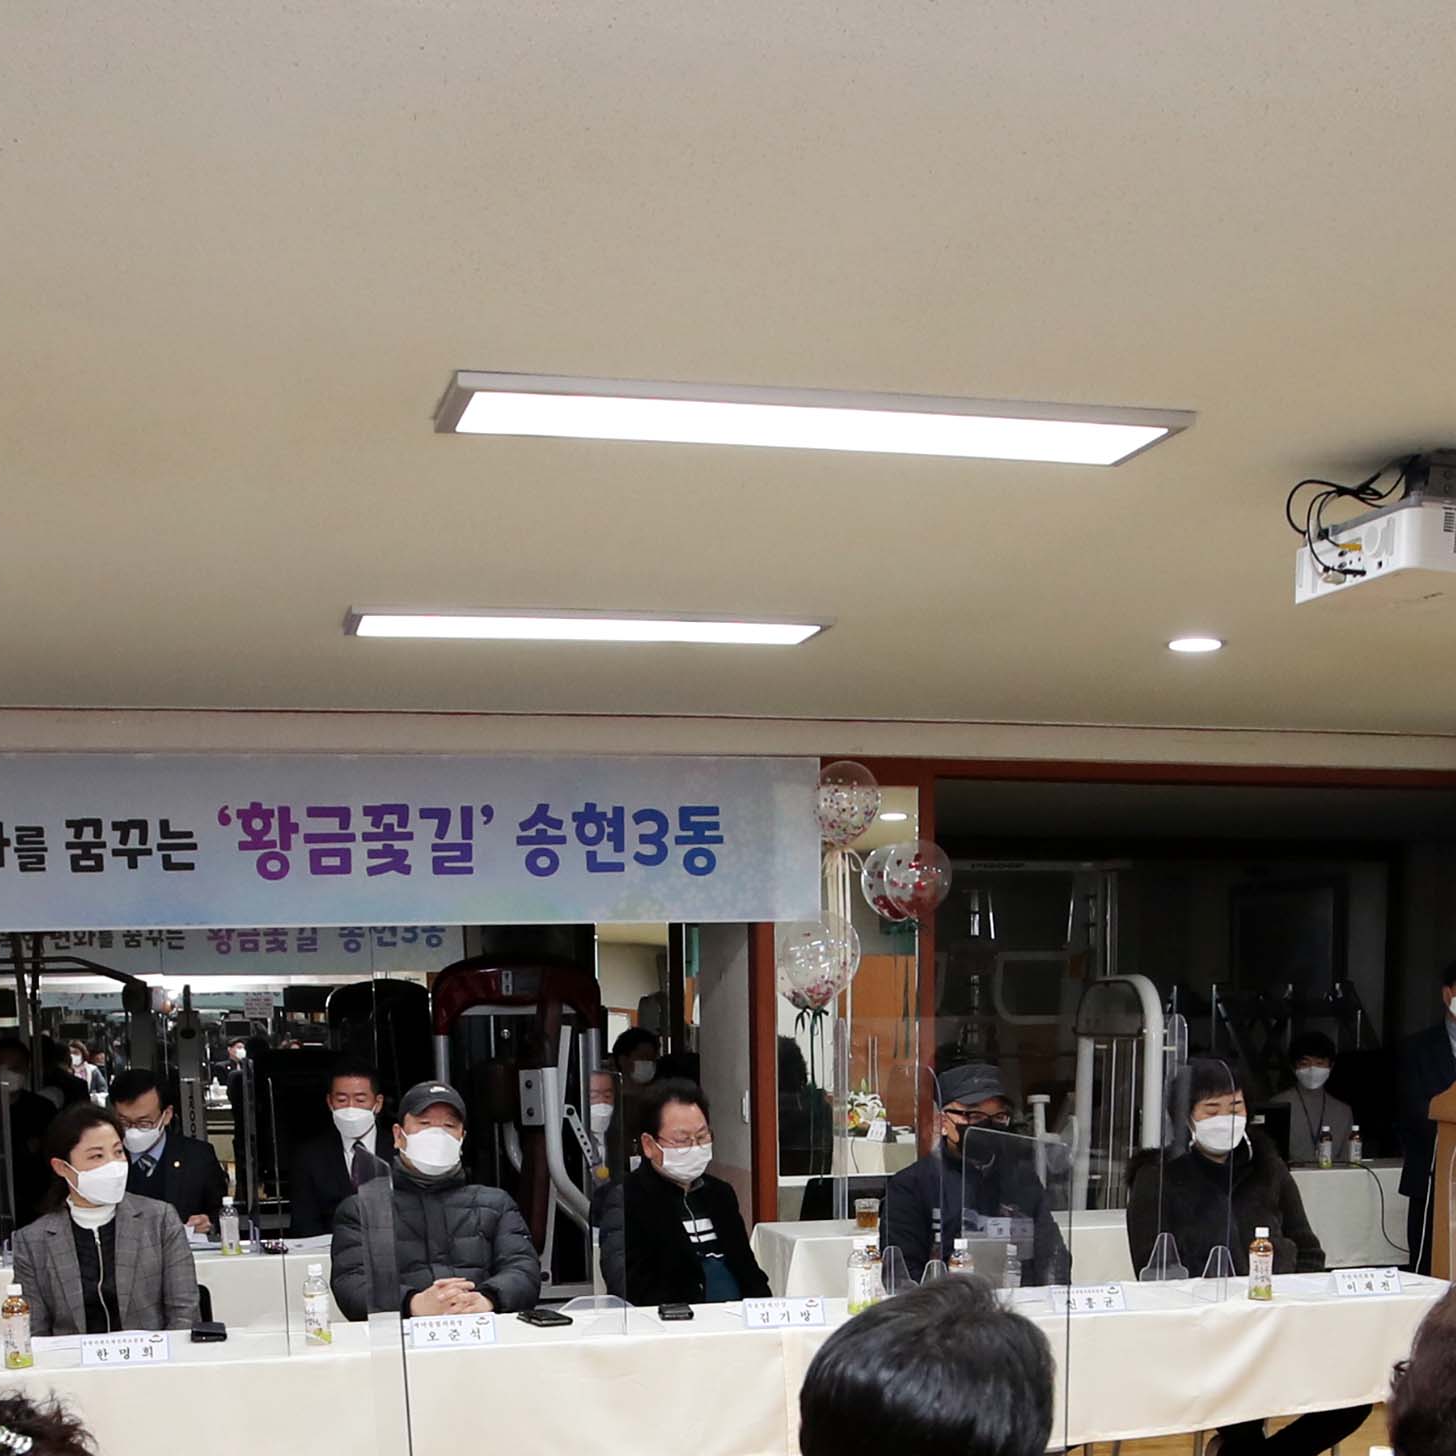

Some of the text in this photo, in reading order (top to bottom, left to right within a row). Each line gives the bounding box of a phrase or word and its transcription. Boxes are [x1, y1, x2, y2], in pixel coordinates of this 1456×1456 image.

[64, 817, 198, 873] 꿈꾸는
[217, 801, 494, 881] ‘황금꽃길’
[516, 801, 725, 877] 송현3동
